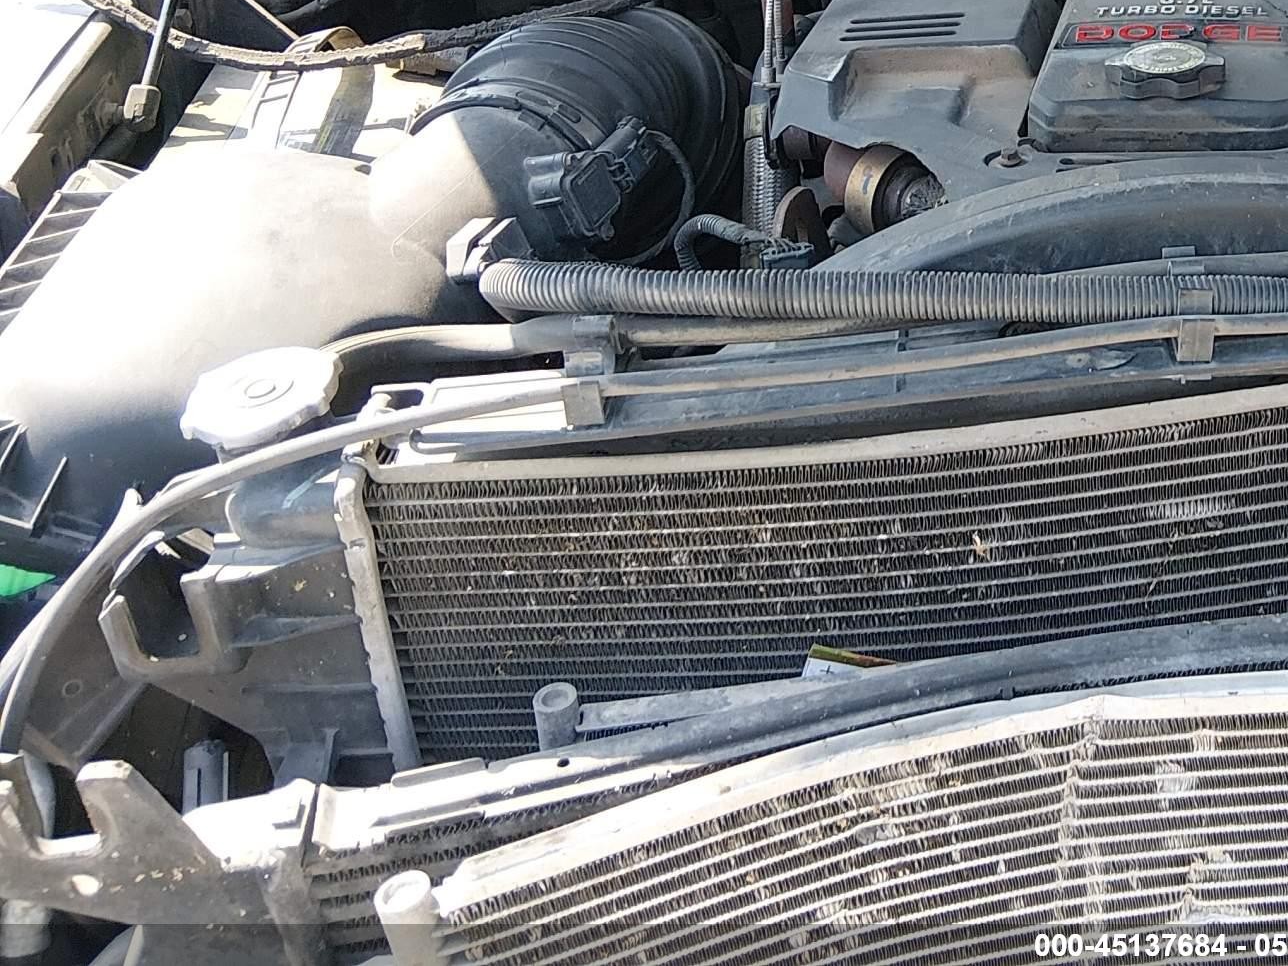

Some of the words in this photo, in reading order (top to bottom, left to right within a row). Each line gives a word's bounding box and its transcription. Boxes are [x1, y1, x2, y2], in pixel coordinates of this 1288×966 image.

[1096, 5, 1177, 17] TURBO
[1185, 5, 1270, 17] DIESEL
[1075, 23, 1283, 43] DODGE
